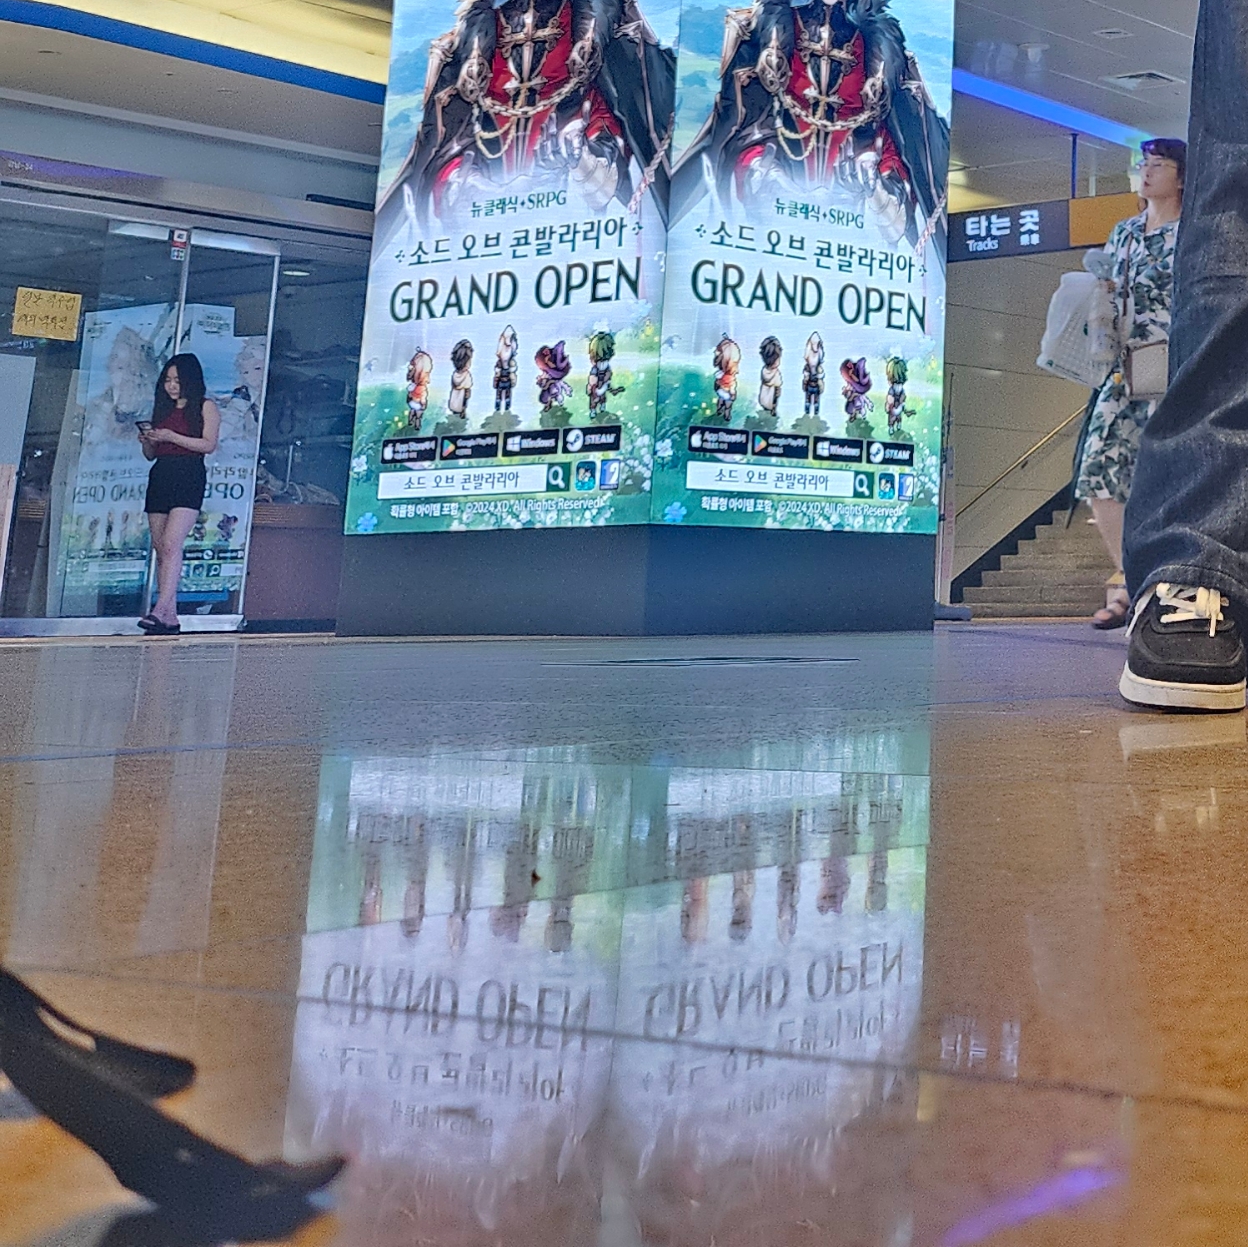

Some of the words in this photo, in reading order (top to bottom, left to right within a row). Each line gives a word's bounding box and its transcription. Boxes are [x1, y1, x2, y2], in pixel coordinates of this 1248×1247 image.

[470, 195, 518, 218] 뉴클래식
[526, 190, 567, 209] SRPG
[774, 197, 820, 222] 뉴클래식
[829, 211, 865, 229] SRPG
[965, 214, 1011, 237] 타는
[1018, 209, 1040, 232] 곳
[408, 238, 452, 266] 소드
[457, 231, 502, 261] 오브
[510, 216, 628, 259] 콘발라리아
[966, 237, 999, 252] Tracks
[710, 221, 756, 252] 소드
[762, 229, 807, 261] 오브
[813, 239, 916, 284] 콘발라리아
[389, 270, 519, 323] GRAND
[534, 256, 642, 309] OPEN
[691, 259, 823, 318] GRAND
[838, 283, 927, 334] OPEN
[522, 438, 556, 449] Windows
[585, 434, 616, 445] STEAM
[829, 445, 860, 457] Windows
[884, 449, 910, 460] STEAM
[403, 477, 427, 490] 소드
[431, 474, 455, 488] 오브
[460, 471, 520, 490] 콘발라리아
[714, 468, 739, 482] 소드
[744, 470, 768, 484] 오브
[773, 472, 829, 491] 콘발라리아
[416, 503, 440, 517] 아이템
[441, 502, 458, 516] 포함
[729, 497, 754, 512] 아이템
[755, 499, 772, 513] 포함
